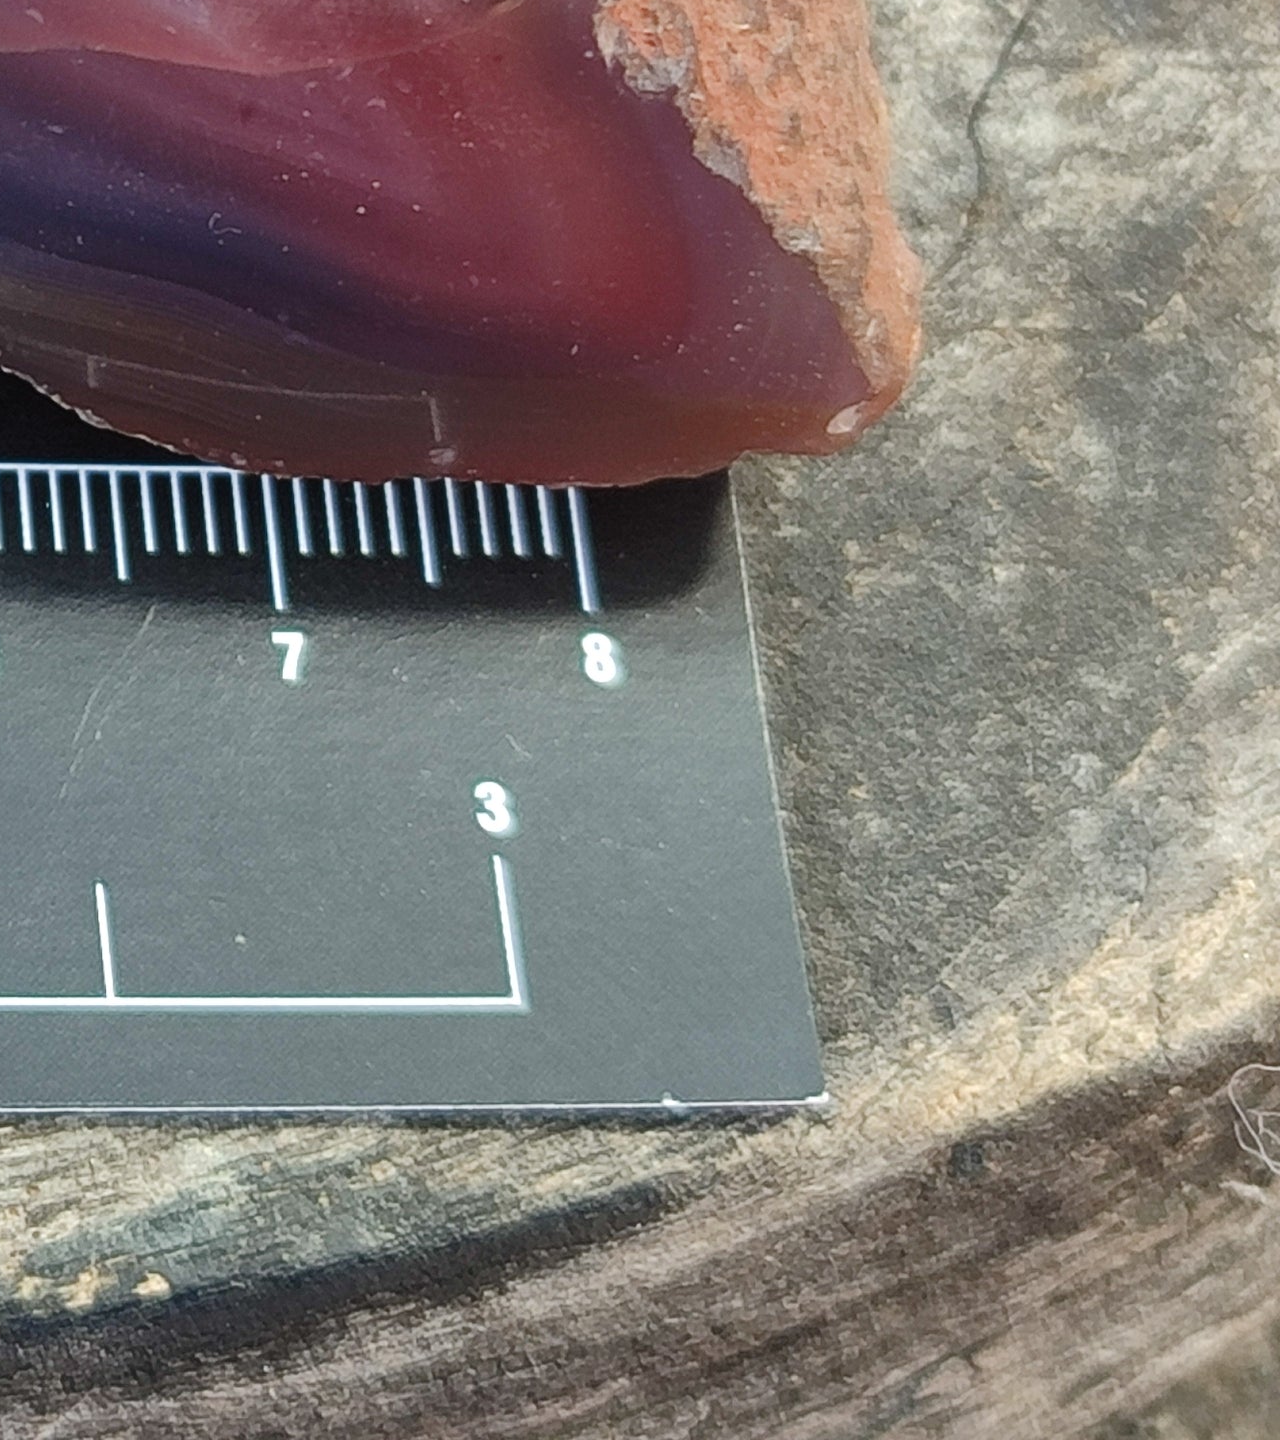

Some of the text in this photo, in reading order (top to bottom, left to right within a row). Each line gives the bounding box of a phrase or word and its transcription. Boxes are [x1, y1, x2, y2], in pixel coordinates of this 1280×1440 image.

[271, 631, 308, 683] 7
[581, 632, 623, 687] 8
[473, 781, 515, 836] 3
